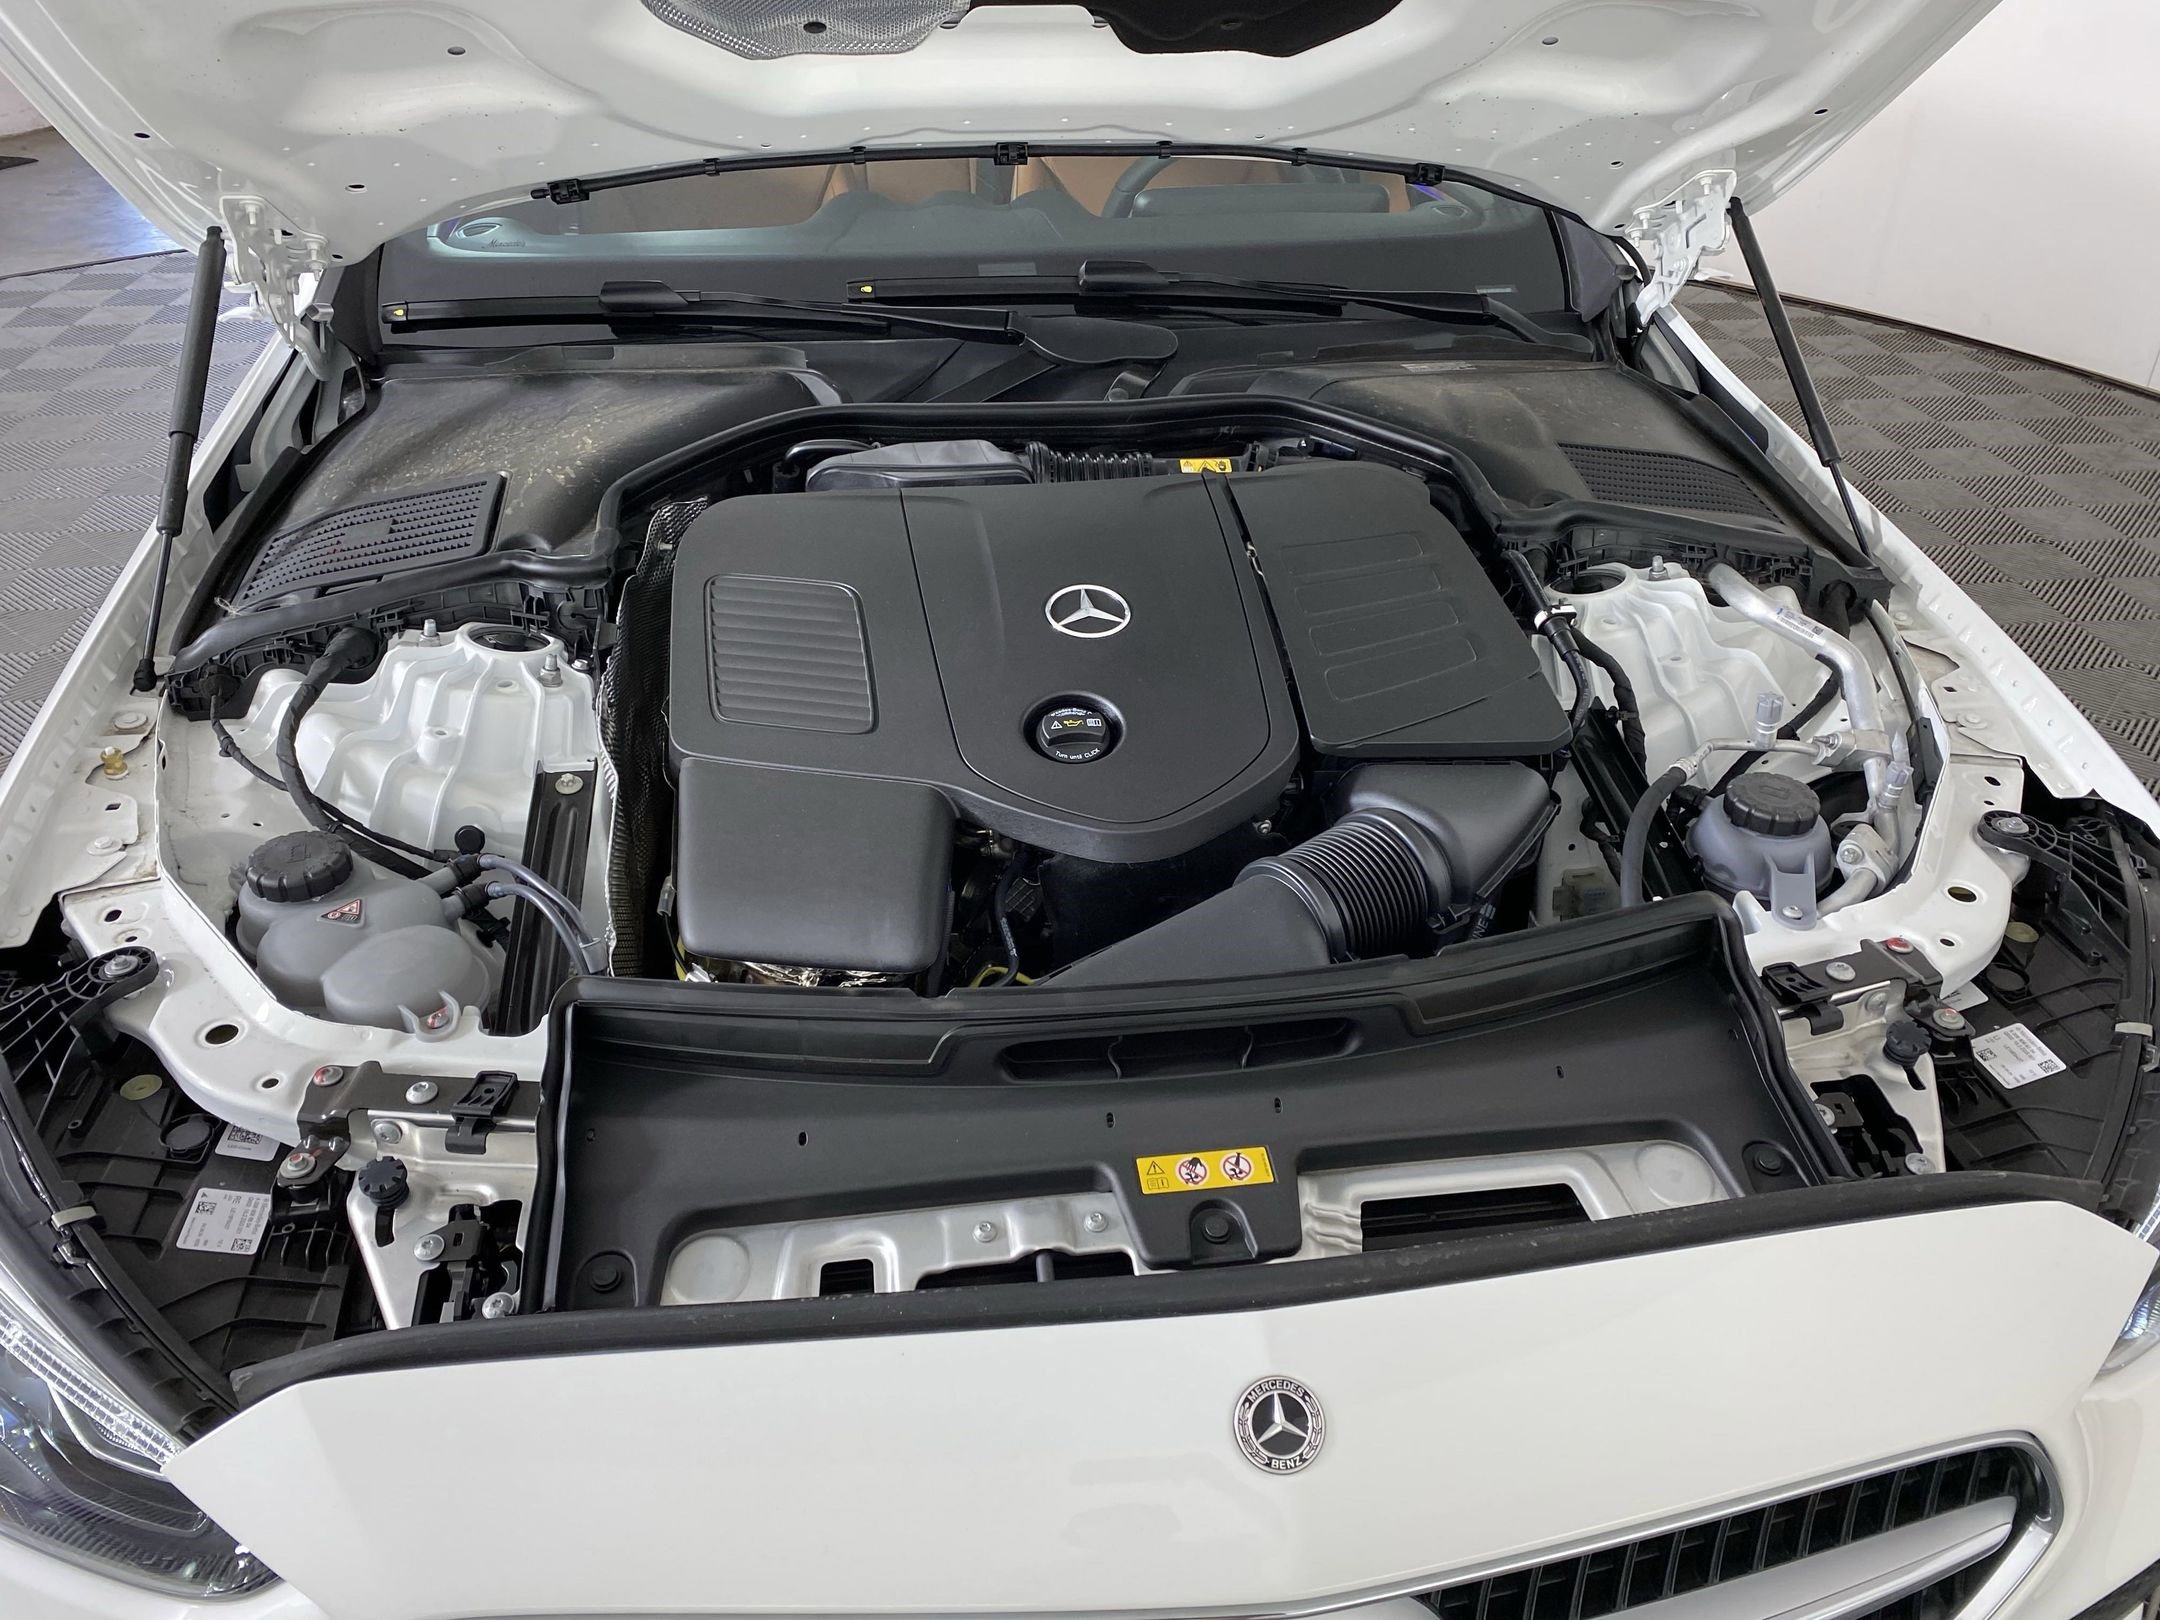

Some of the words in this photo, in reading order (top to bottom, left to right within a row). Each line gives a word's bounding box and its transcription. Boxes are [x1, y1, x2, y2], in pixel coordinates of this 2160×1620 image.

[1055, 750, 1068, 759] Turn
[1084, 748, 1101, 758] CLICK
[1247, 1380, 1305, 1402] MERCEDES
[1271, 1456, 1303, 1470] BENZ
